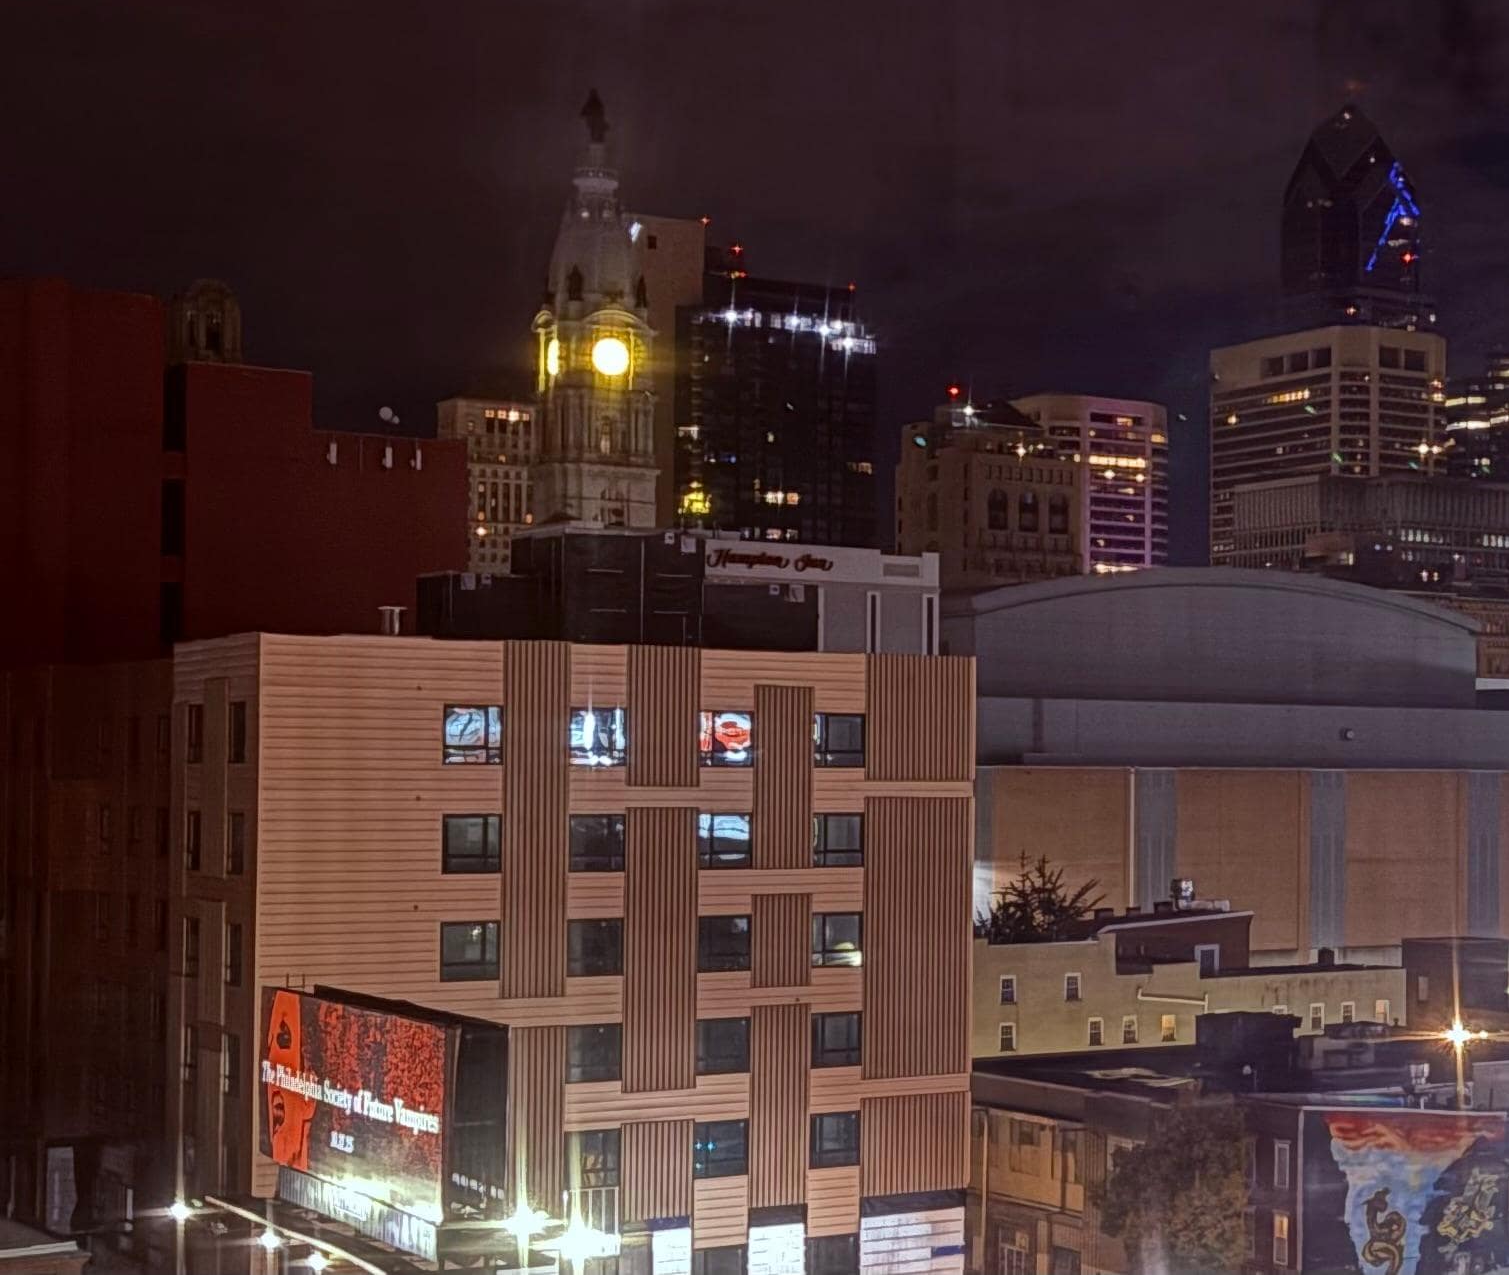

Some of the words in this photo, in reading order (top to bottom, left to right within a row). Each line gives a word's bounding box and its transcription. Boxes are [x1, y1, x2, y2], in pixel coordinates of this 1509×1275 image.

[706, 549, 790, 569] Hampton
[794, 554, 833, 572] Inn
[262, 1060, 275, 1084] The
[276, 1063, 323, 1102] Philadelphia
[323, 1078, 353, 1116] Society
[353, 1089, 363, 1114] of
[363, 1090, 394, 1123] Future
[393, 1097, 440, 1136] Vampires
